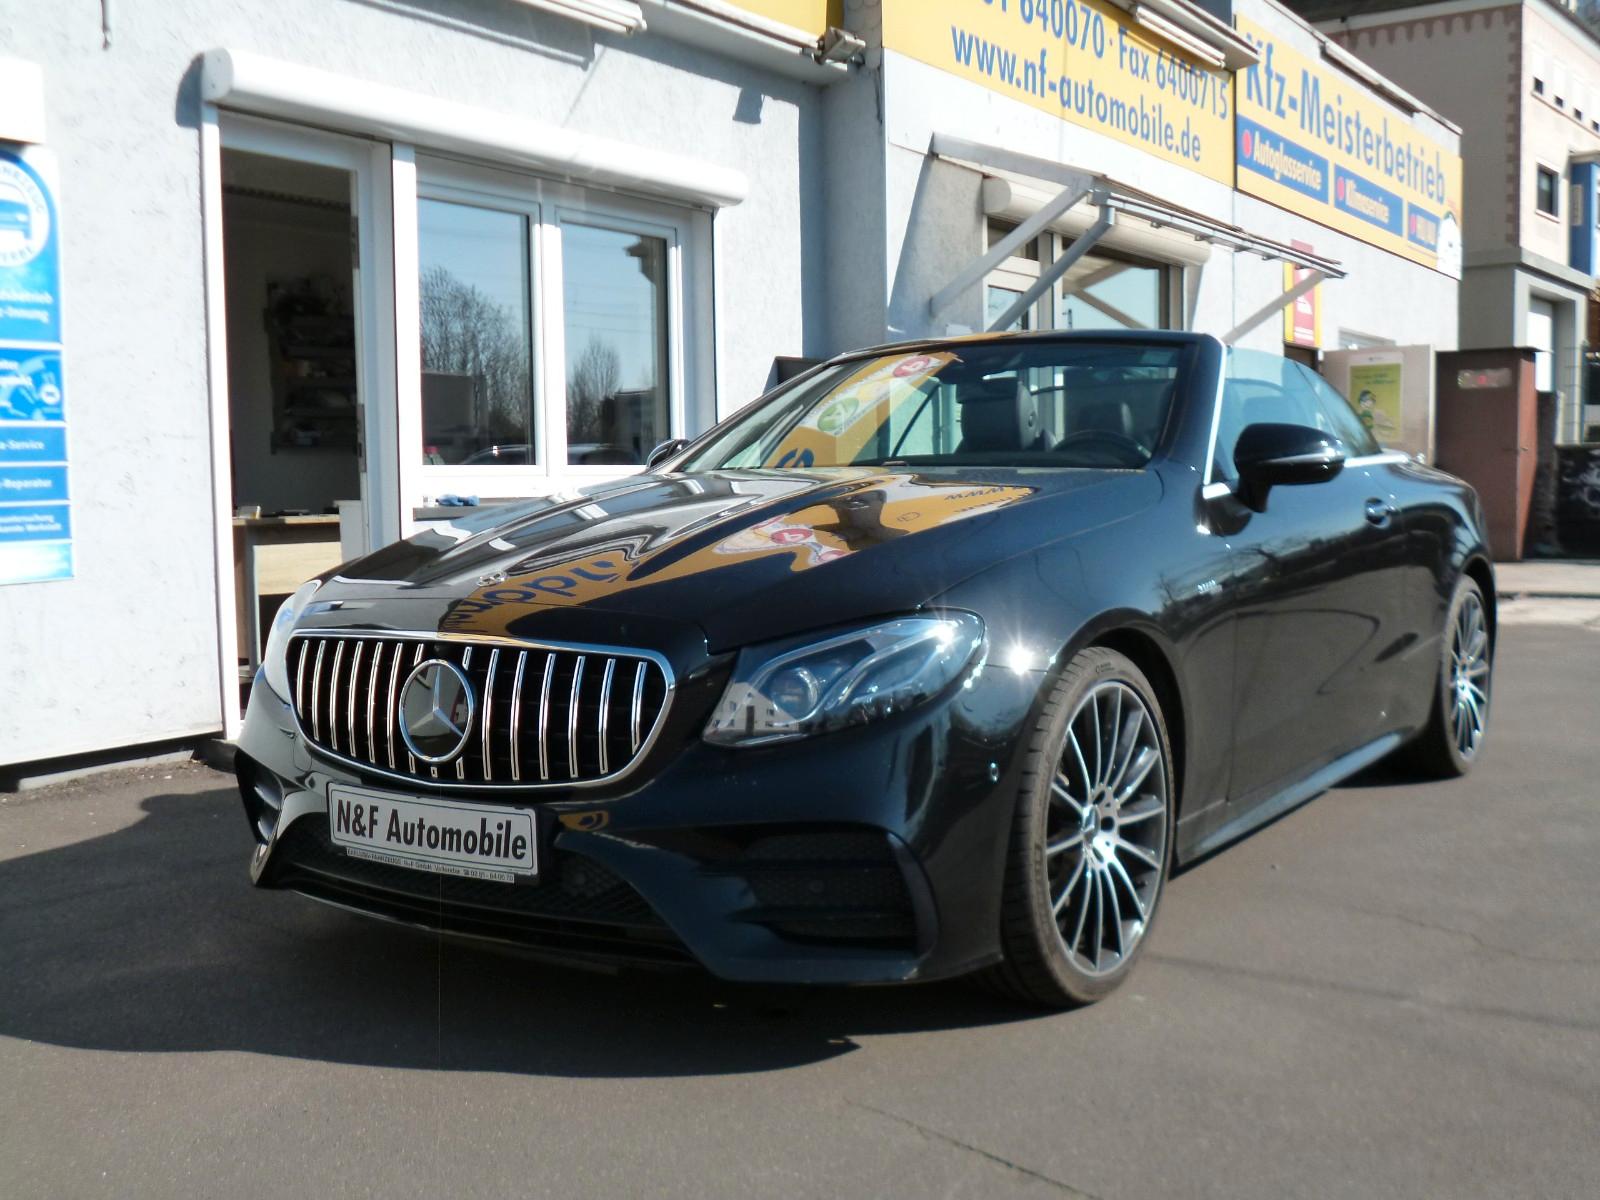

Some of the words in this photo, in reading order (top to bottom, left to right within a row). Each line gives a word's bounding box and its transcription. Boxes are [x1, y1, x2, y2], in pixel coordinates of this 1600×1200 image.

[951, 25, 1201, 163] www.nf-automobile.de
[1118, 26, 1150, 83] Fax
[1156, 49, 1228, 120] 6400715
[1246, 32, 1445, 205] Kfz-Meisterbetrieb
[336, 799, 379, 839] N&F
[386, 808, 527, 860] Automobile
